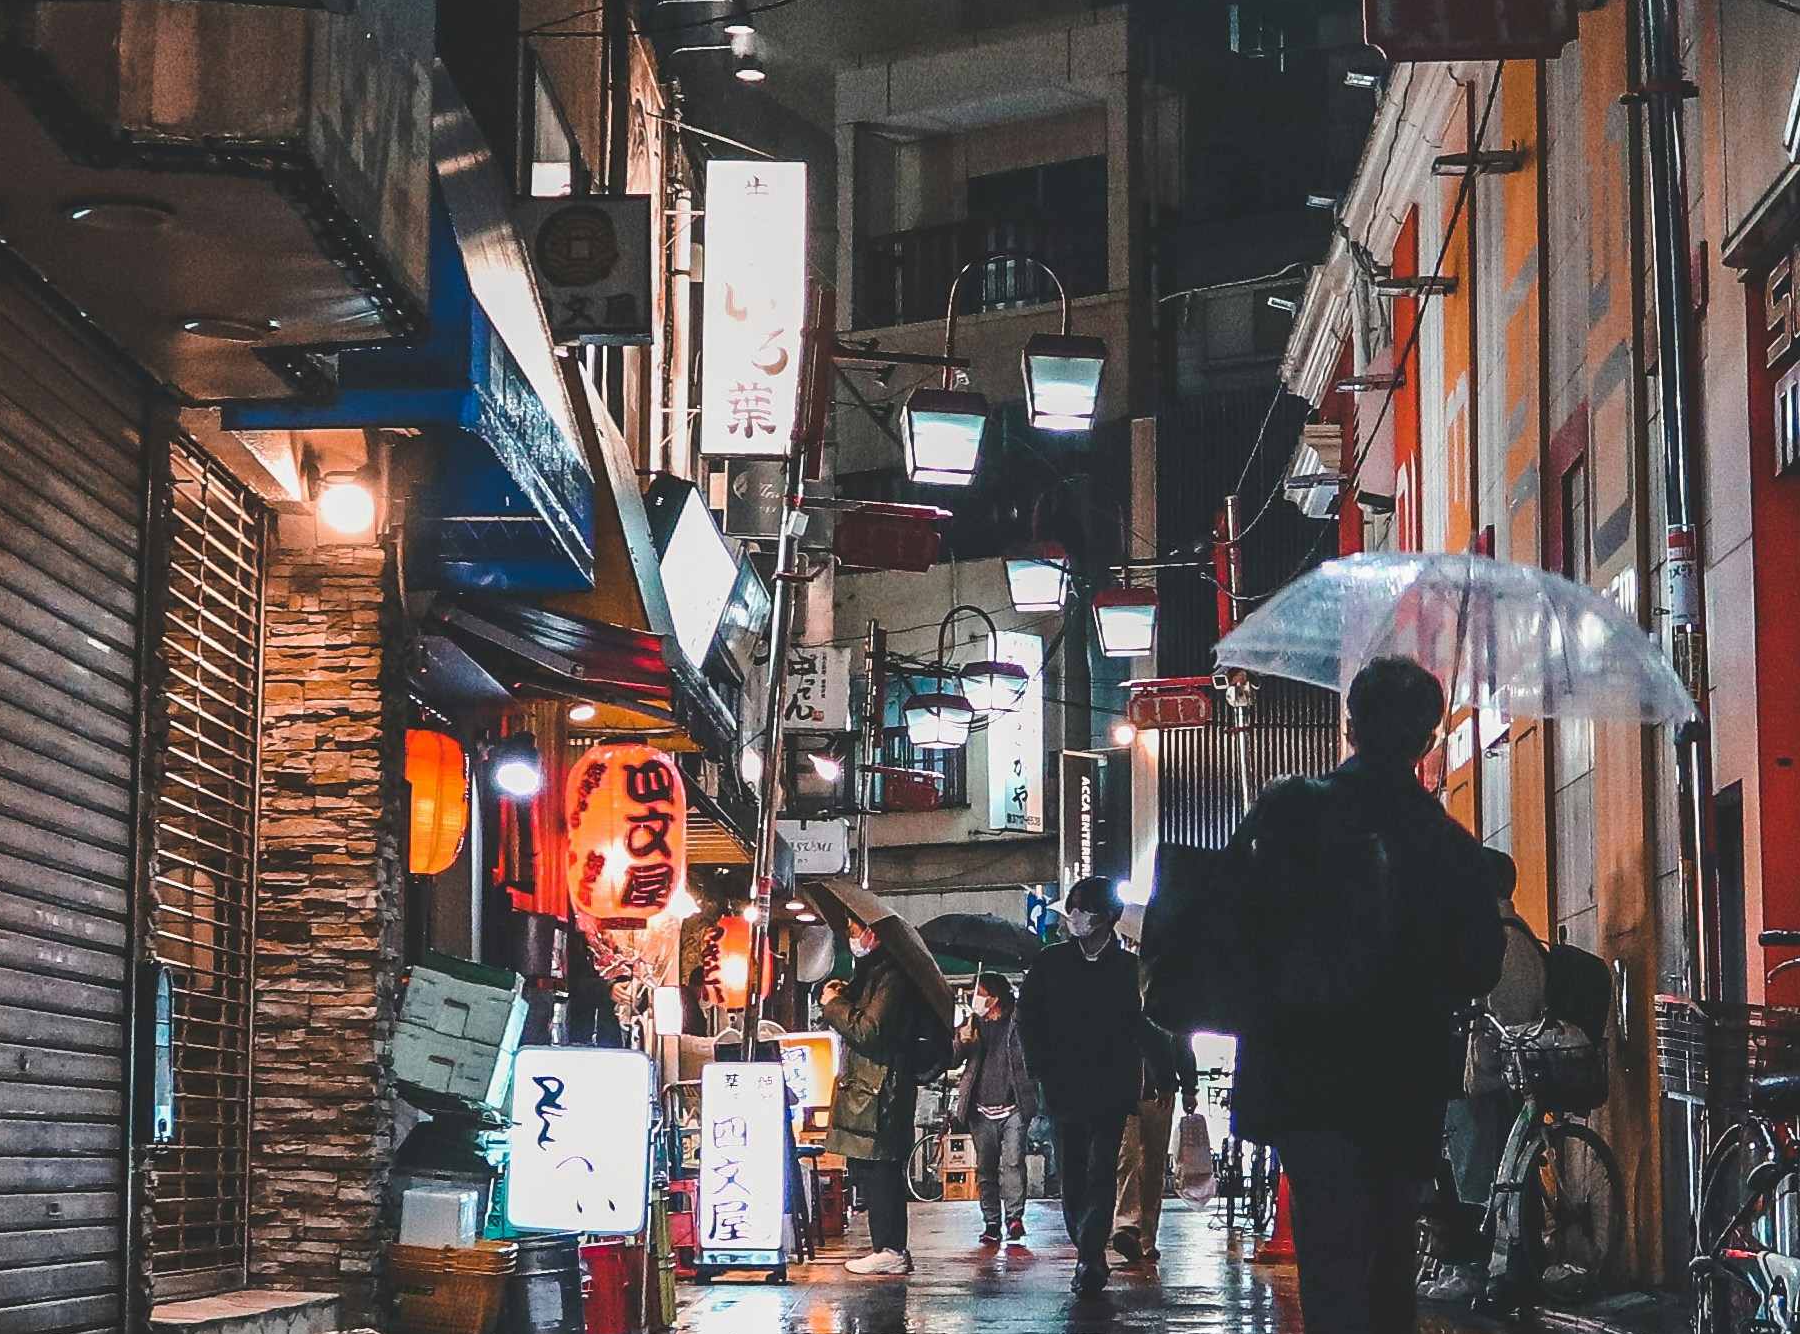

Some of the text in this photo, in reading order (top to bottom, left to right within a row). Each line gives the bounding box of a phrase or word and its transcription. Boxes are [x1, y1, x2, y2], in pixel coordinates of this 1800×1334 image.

[621, 760, 674, 909] 四文屋
[1081, 776, 1091, 812] ACCA
[708, 1116, 752, 1241] 四文屋
